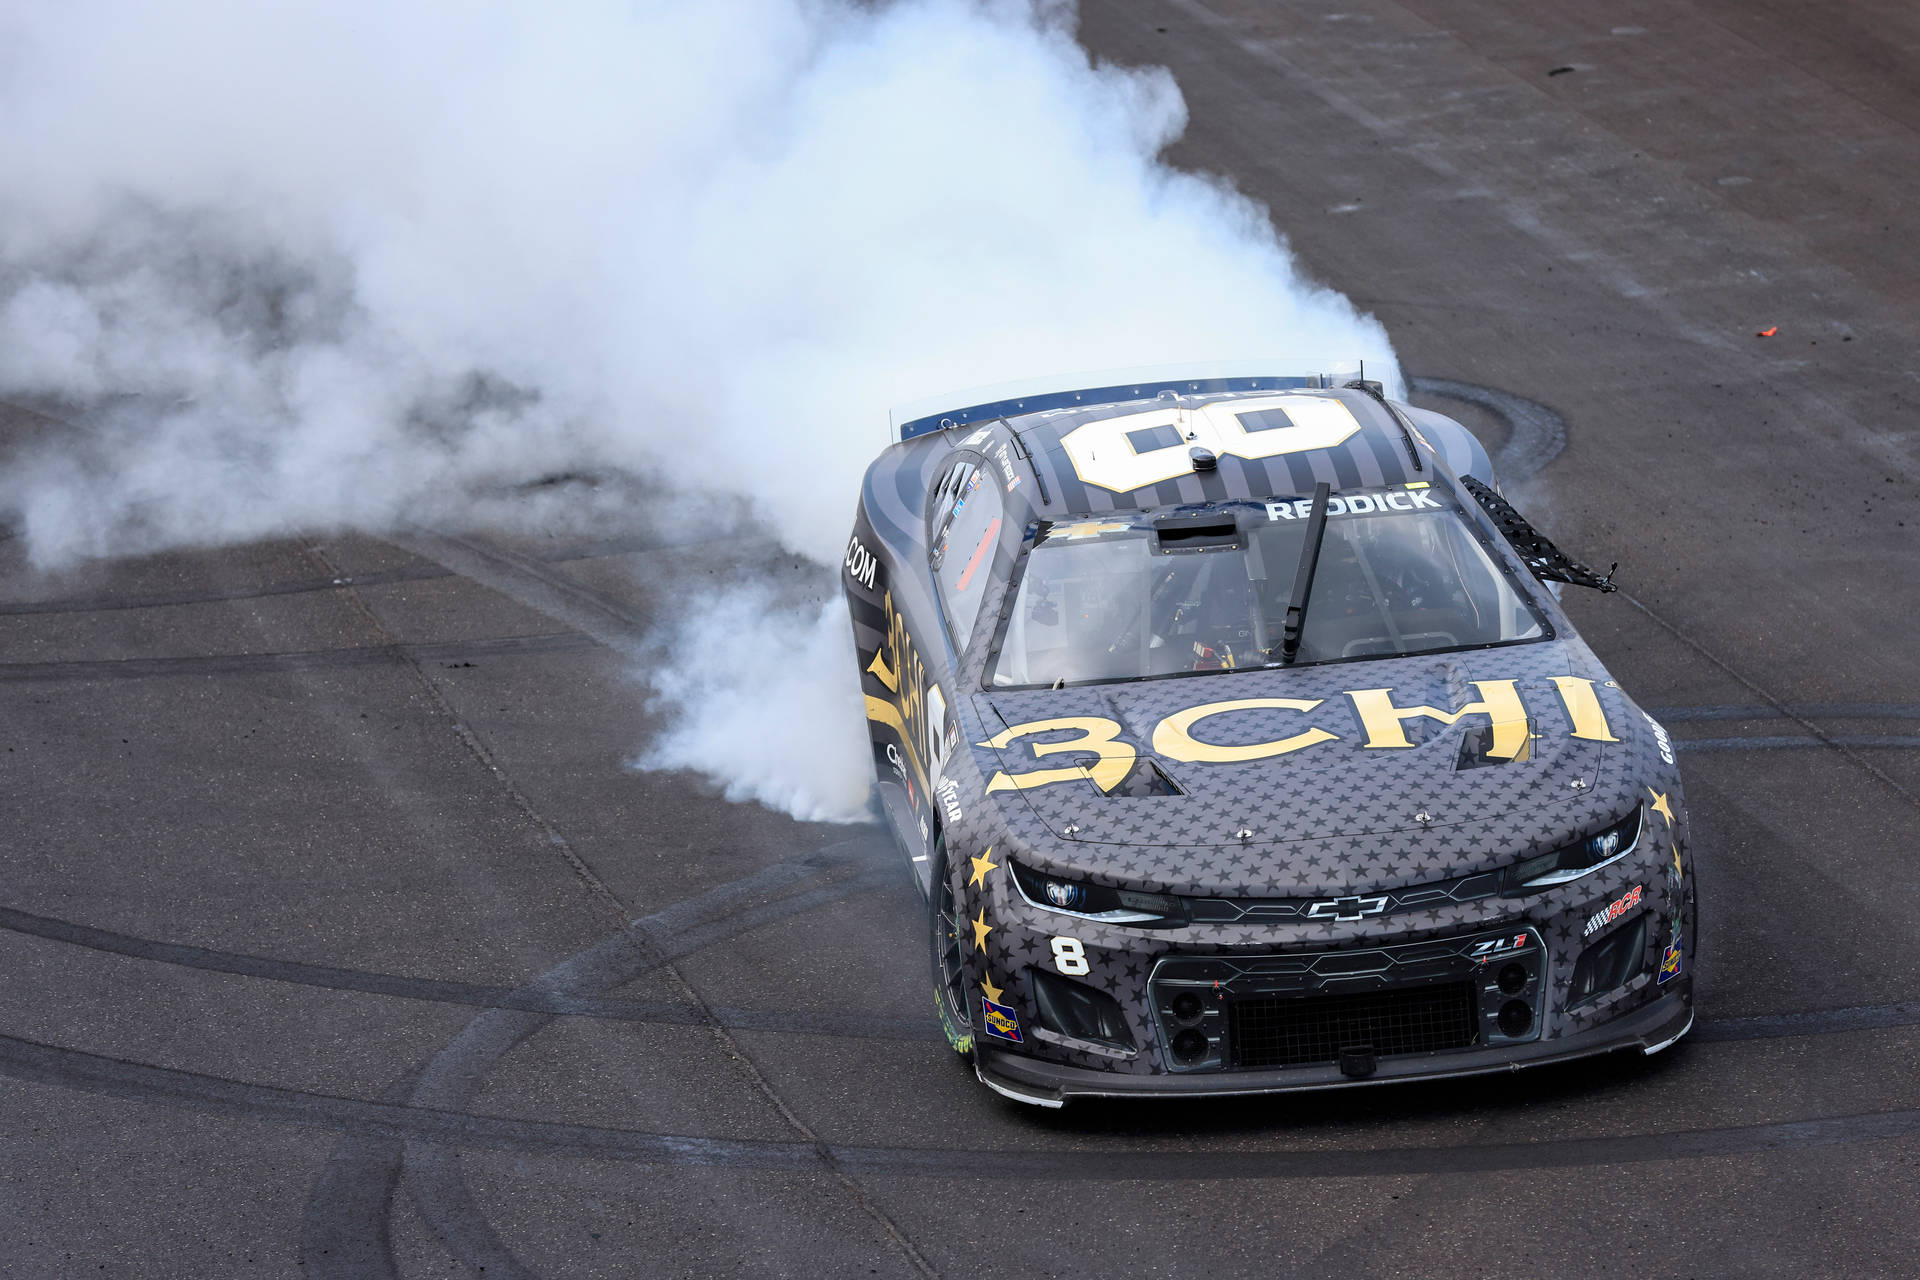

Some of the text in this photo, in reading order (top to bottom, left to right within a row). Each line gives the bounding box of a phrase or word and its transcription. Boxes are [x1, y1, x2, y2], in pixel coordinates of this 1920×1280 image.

[1265, 489, 1442, 521] REDDICK
[976, 676, 1620, 795] 3CHI
[1607, 885, 1642, 923] RCR
[1050, 936, 1091, 976] 8
[1470, 934, 1527, 957] ZL1
[986, 1014, 1016, 1030] SUNOCO
